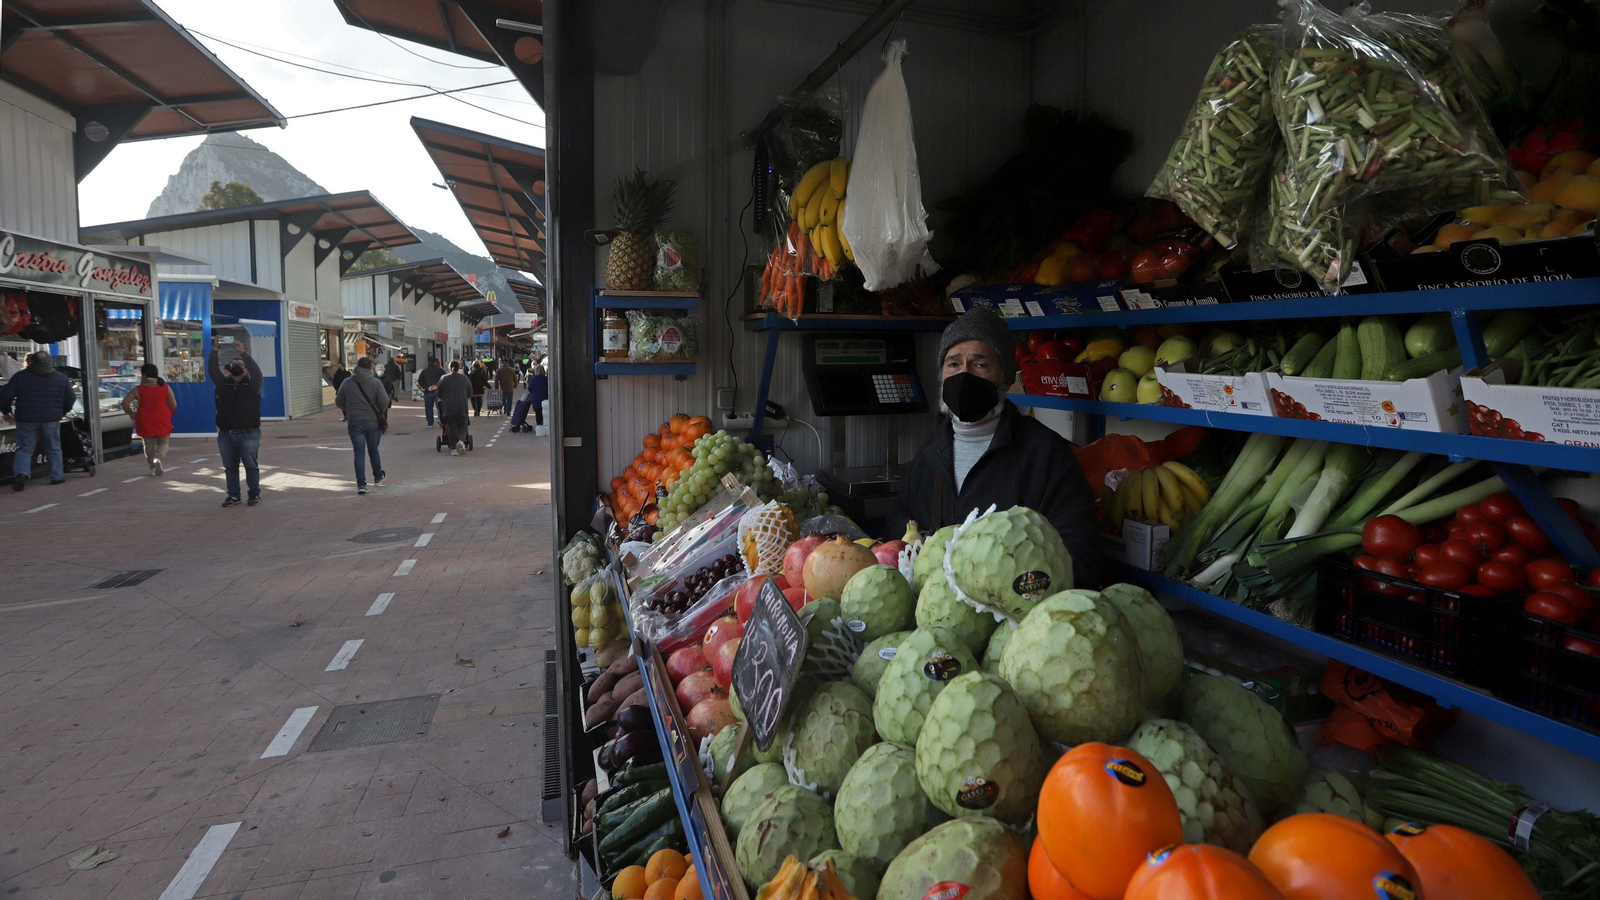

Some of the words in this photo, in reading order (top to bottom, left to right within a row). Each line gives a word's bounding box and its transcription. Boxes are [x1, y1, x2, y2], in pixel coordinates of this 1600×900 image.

[0, 235, 70, 274] Castro
[77, 252, 150, 294] González
[1417, 283, 1451, 291] FINCA
[1511, 276, 1529, 284] DE
[1250, 294, 1273, 302] FINCA
[1273, 290, 1308, 300] SEÑORÍO
[1041, 375, 1060, 391] envy
